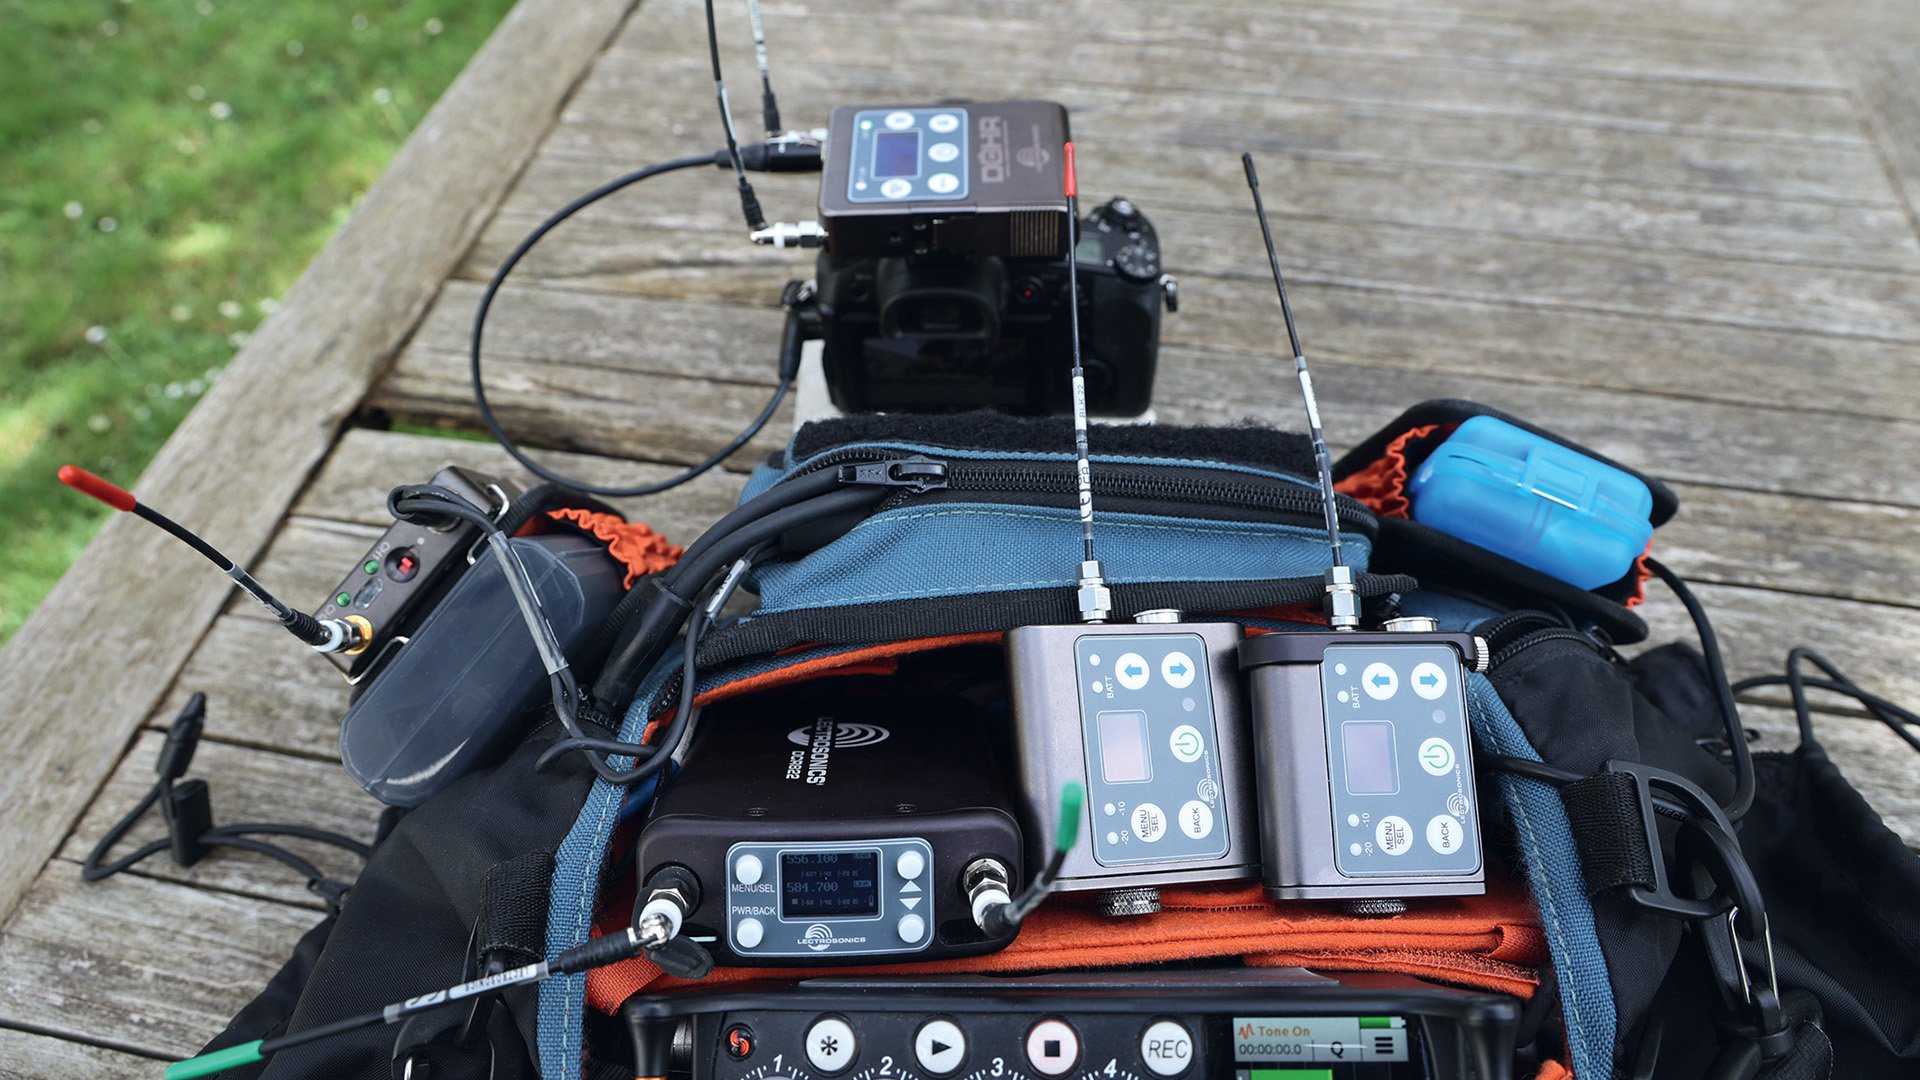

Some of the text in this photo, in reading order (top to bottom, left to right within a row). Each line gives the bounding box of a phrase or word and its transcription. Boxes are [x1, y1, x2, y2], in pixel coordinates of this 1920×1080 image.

[372, 541, 390, 560] CH1
[1106, 676, 1115, 699] BATT
[1352, 685, 1361, 709] BATT
[806, 717, 834, 785] LECTROSONICS
[786, 751, 805, 780] DCR822
[1454, 764, 1466, 824] LECTROSONICS
[1118, 801, 1126, 816] -10
[1140, 809, 1150, 838] MENU
[1151, 813, 1159, 832] SEL
[1193, 807, 1202, 834] BACK
[1361, 812, 1370, 828] -10
[1121, 829, 1130, 845] -20
[1386, 821, 1394, 850] MENU
[1396, 826, 1405, 845] SEL
[1442, 822, 1450, 848] BACK
[786, 853, 838, 864] 556.100
[1364, 841, 1374, 857] -20
[731, 883, 775, 893] MENU/SEL
[786, 881, 839, 893] 584.700
[731, 906, 776, 916] PWR/BACK
[797, 937, 866, 945] LECTROSONICS
[1258, 1026, 1311, 1037] Tone On
[1148, 1040, 1188, 1059] REC
[1239, 1044, 1302, 1055] 00:00:00.0
[772, 1054, 784, 1073] 1
[879, 1056, 894, 1075] 2
[990, 1058, 1005, 1077] 3
[1103, 1059, 1118, 1078] 4
